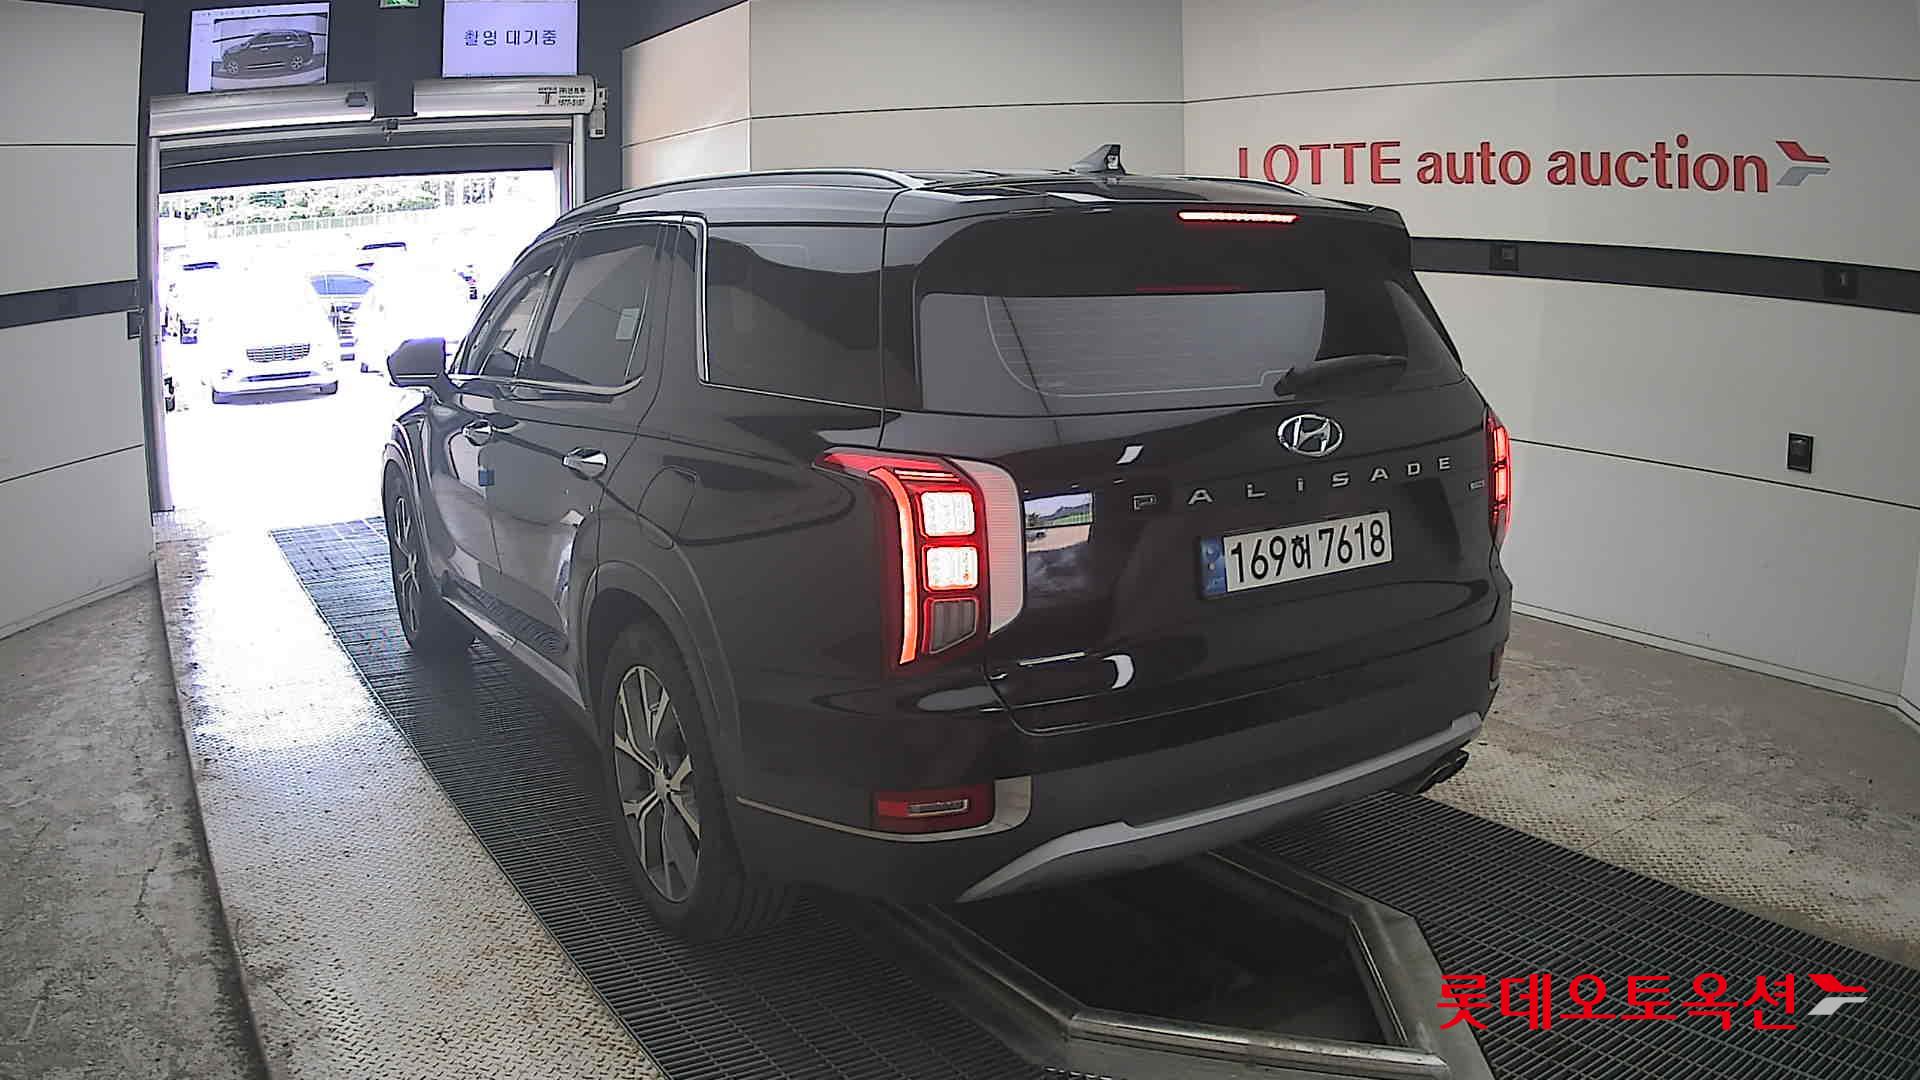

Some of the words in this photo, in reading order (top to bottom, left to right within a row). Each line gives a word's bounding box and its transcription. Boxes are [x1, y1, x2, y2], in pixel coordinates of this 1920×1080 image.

[505, 29, 558, 46] 대기중
[1415, 141, 1532, 186] auto
[1546, 133, 1769, 193] auction
[1133, 456, 1453, 510] PALISADE
